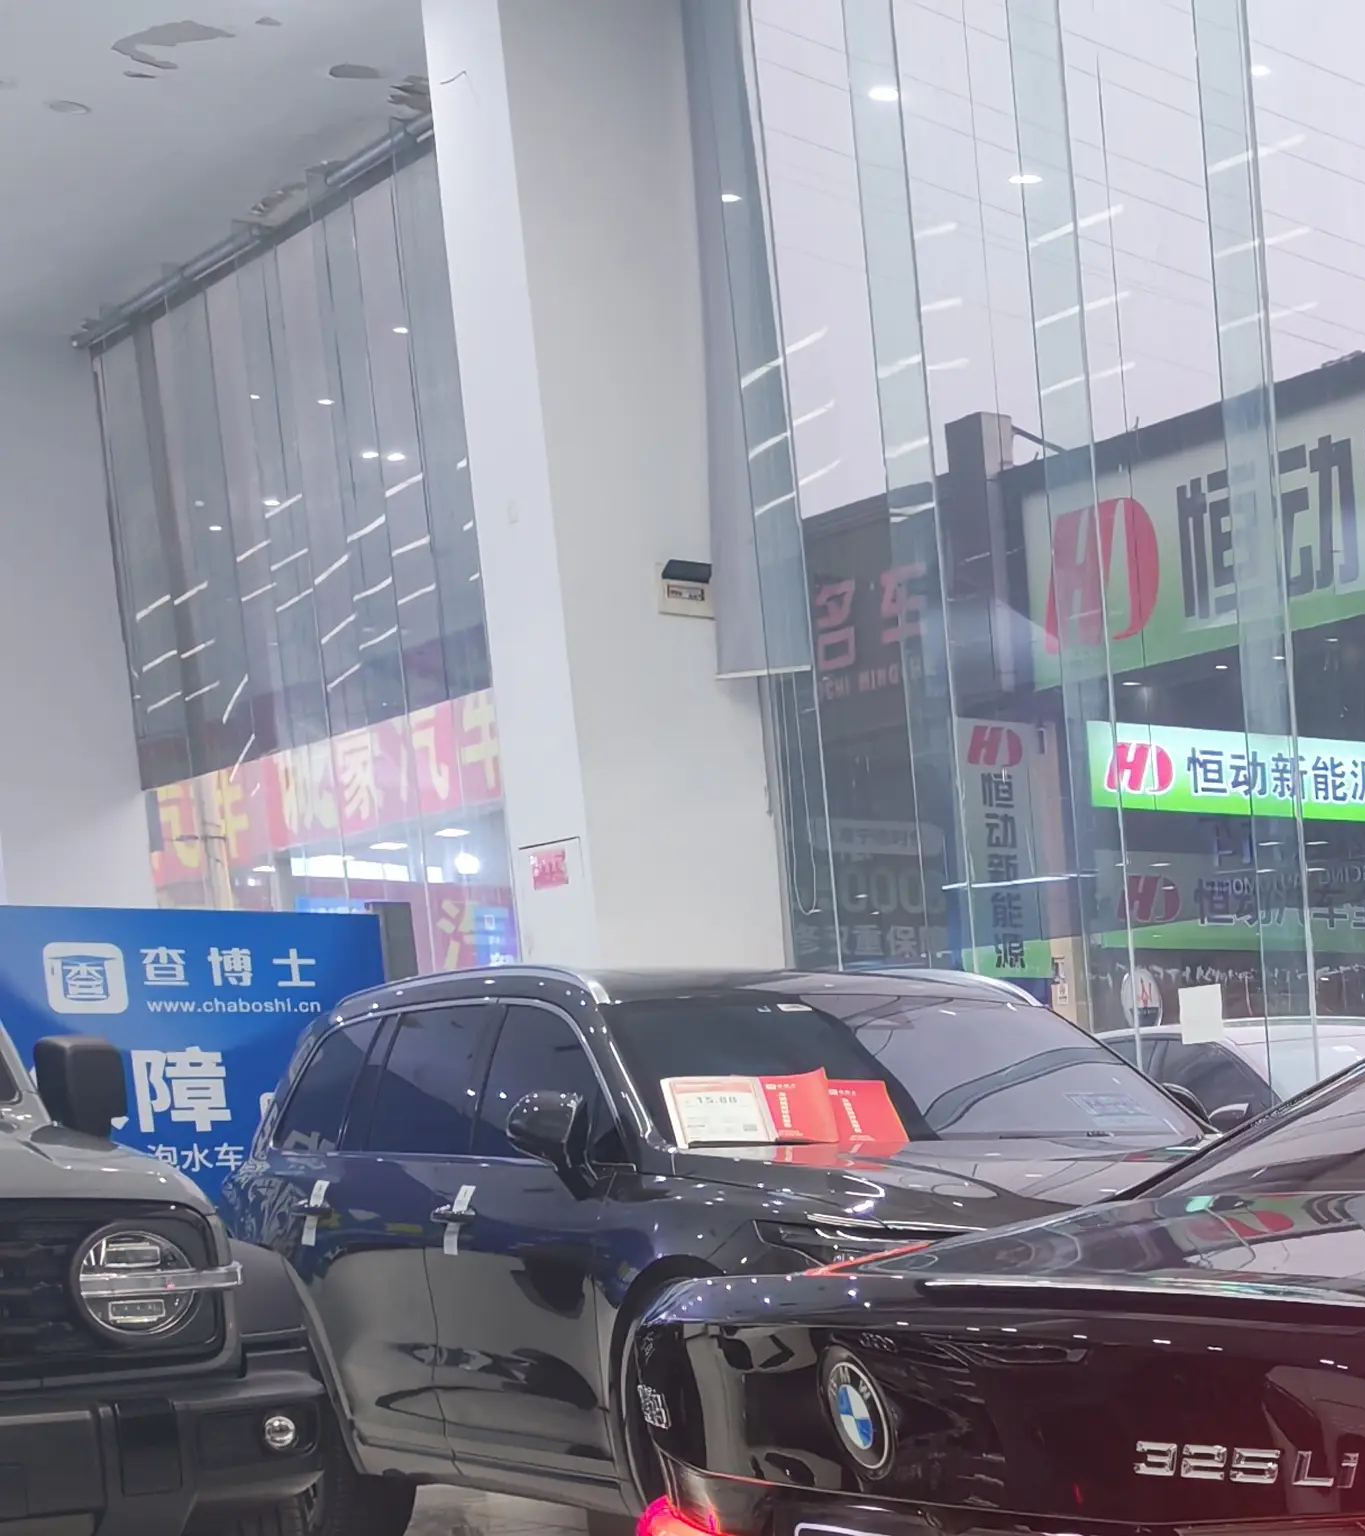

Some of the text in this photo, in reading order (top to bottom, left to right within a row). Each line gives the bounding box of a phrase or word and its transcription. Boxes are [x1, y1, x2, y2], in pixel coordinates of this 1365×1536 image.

[982, 773, 1026, 969] 恒动新能源
[140, 946, 316, 988] 查博士
[147, 997, 321, 1014] www.chaboshi.cn
[131, 1046, 232, 1133] 障
[147, 1142, 244, 1173] 泡水车
